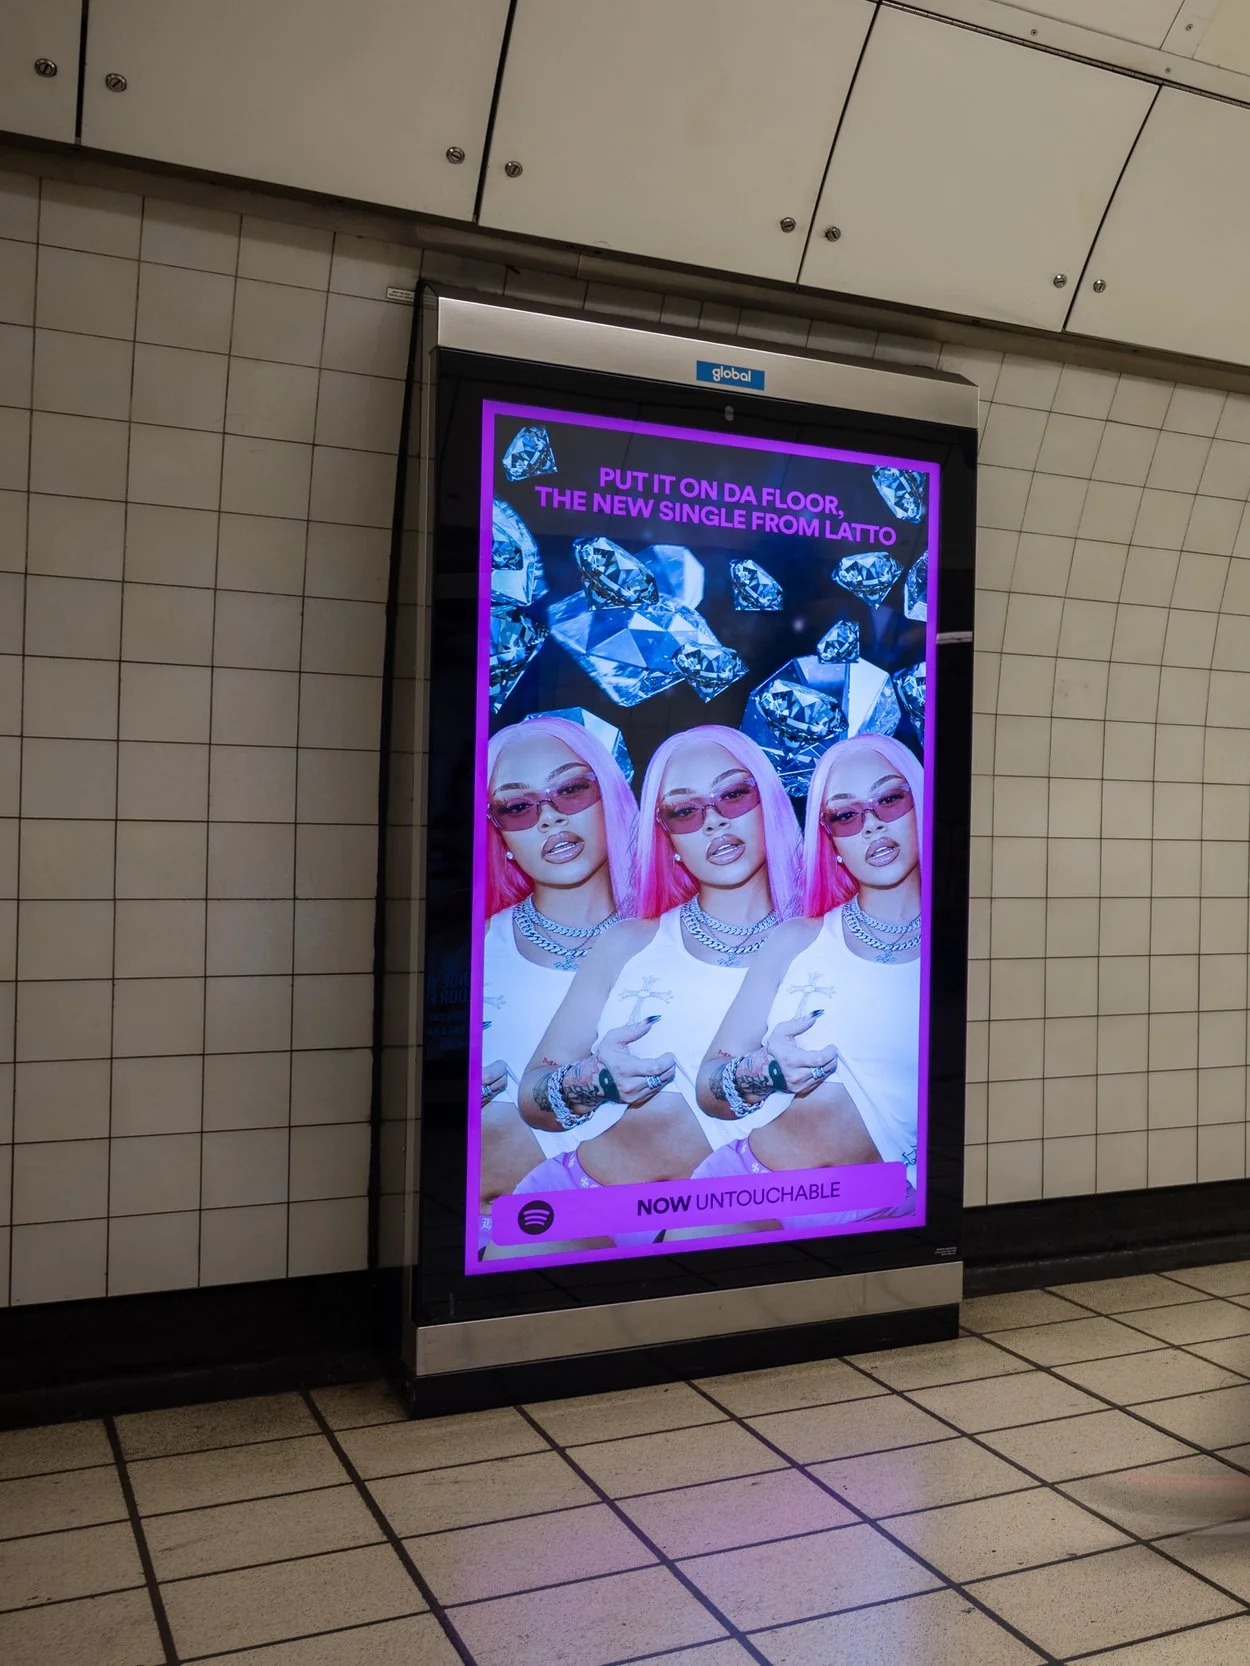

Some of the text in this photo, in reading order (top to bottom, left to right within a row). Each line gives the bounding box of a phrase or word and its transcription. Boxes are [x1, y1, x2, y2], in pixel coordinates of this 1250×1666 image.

[712, 366, 751, 382] global
[600, 467, 845, 519] PUT IT ON DA FLOOR,
[534, 486, 897, 546] THE NEW SINGLE FROM LATTO
[637, 1182, 841, 1216] NOW UNTOUCHABLE
